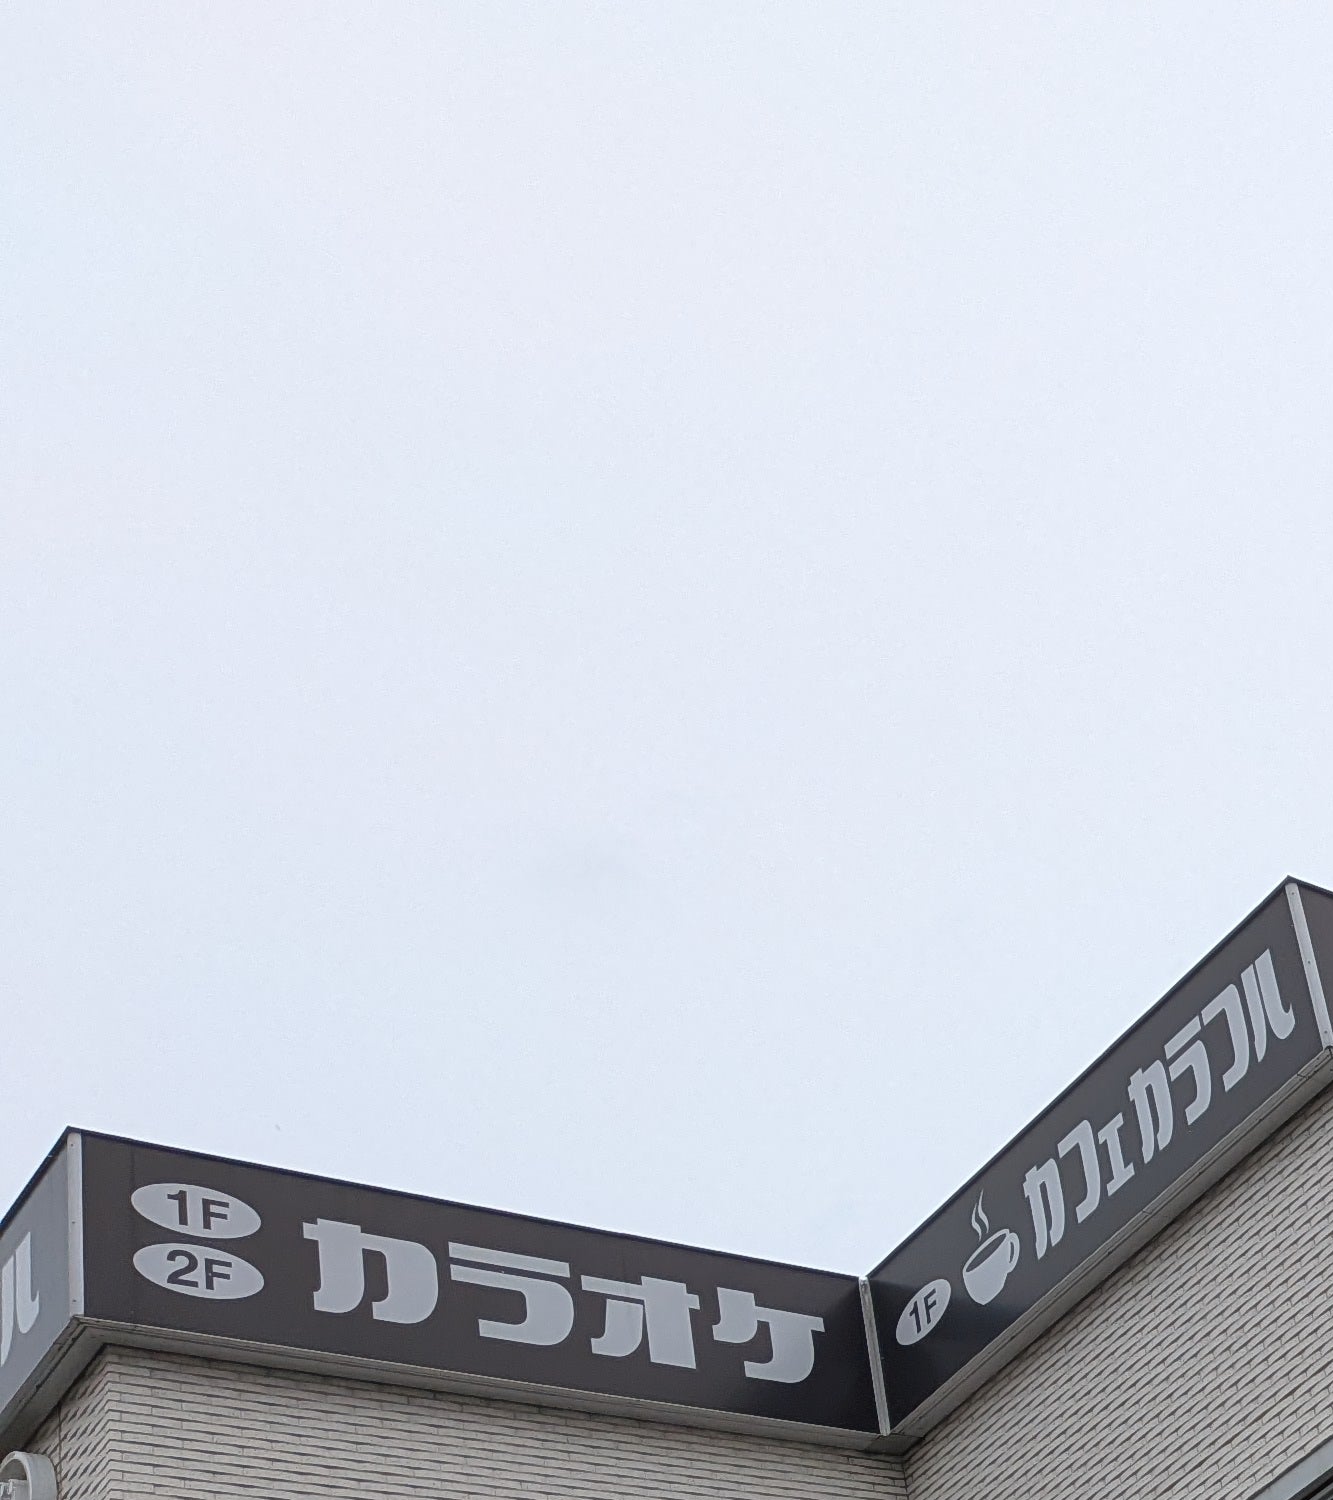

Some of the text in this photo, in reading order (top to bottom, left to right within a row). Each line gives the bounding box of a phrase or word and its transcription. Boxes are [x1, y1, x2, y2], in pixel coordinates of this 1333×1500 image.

[1023, 949, 1295, 1260] カフェカラフル
[166, 1189, 230, 1231] 1F
[166, 1248, 233, 1291] 2F
[302, 1217, 824, 1384] カラオケ
[907, 1285, 942, 1337] 1F
